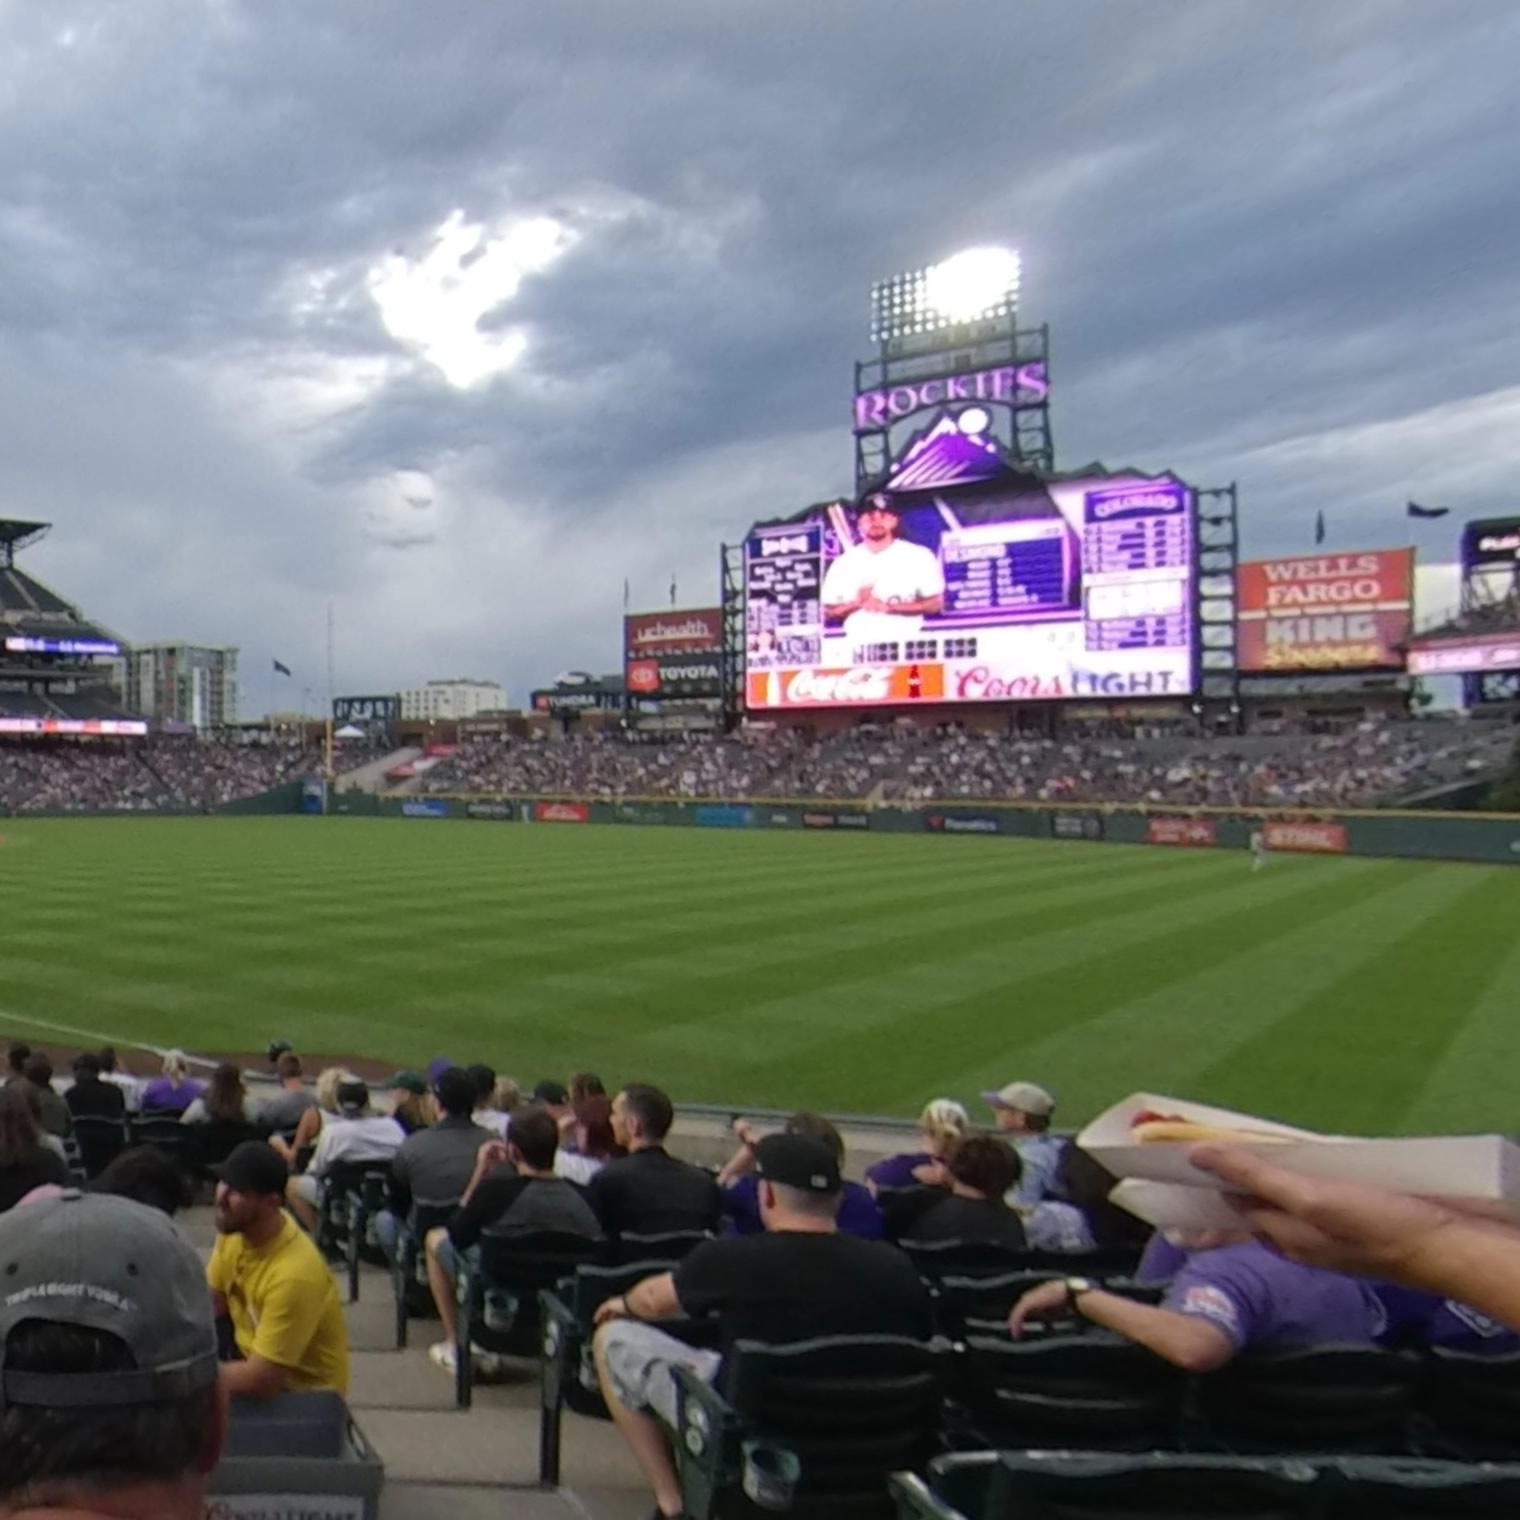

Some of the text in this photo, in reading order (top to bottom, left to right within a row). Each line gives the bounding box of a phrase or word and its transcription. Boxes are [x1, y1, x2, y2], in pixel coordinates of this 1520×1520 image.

[855, 361, 1050, 428] ROCKIES
[1263, 555, 1378, 583] WELLS
[1266, 579, 1381, 606] FARGO
[637, 619, 710, 641] uchealth
[1264, 614, 1376, 645] KING
[659, 665, 719, 681] TOYOTA
[786, 666, 895, 702] Coca-Cola
[955, 666, 1175, 699] Coors LIGHT
